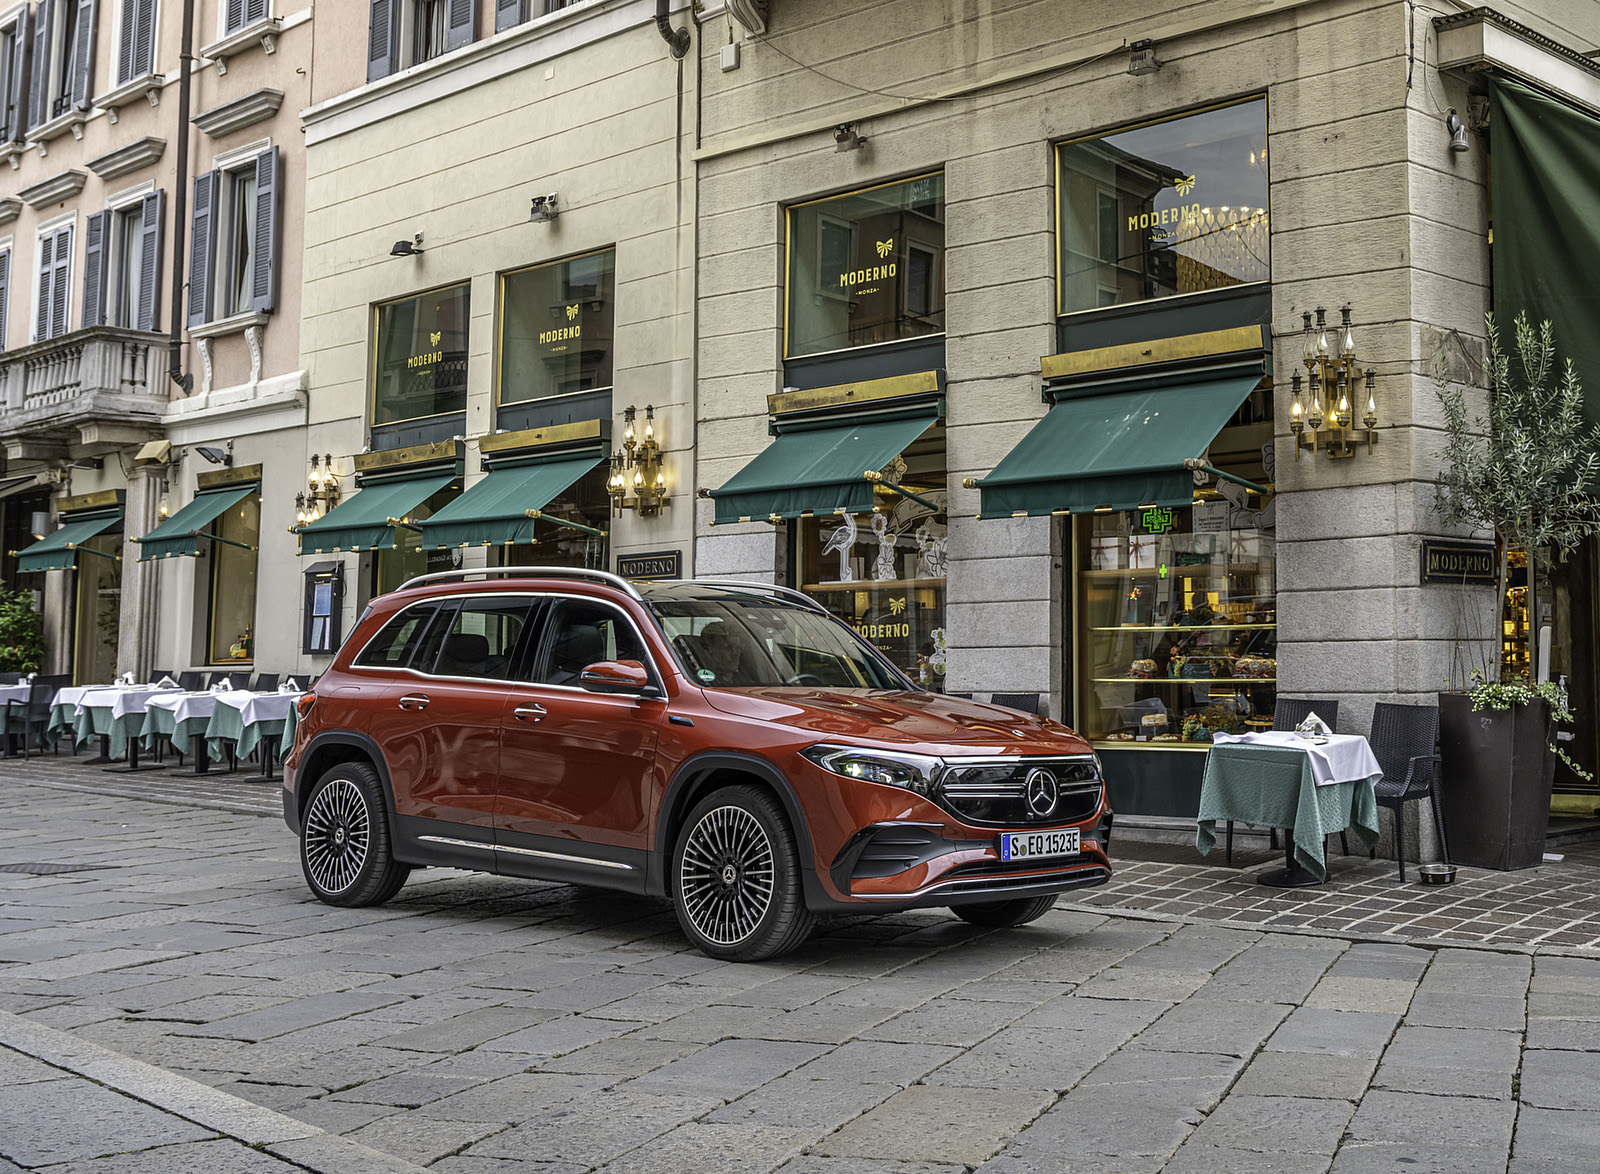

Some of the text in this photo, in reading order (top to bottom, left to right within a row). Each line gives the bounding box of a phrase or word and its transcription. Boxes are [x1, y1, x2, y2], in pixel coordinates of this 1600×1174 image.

[1128, 203, 1200, 231] MODERNO
[840, 263, 896, 287] MODERNO
[539, 325, 581, 344] MODERNO
[407, 350, 443, 369] MODERNO
[621, 559, 674, 575] MODERNO
[1430, 553, 1490, 572] MODERNO
[1011, 837, 1019, 857] S
[1028, 835, 1044, 856] EQ
[1045, 832, 1079, 855] 1523E
